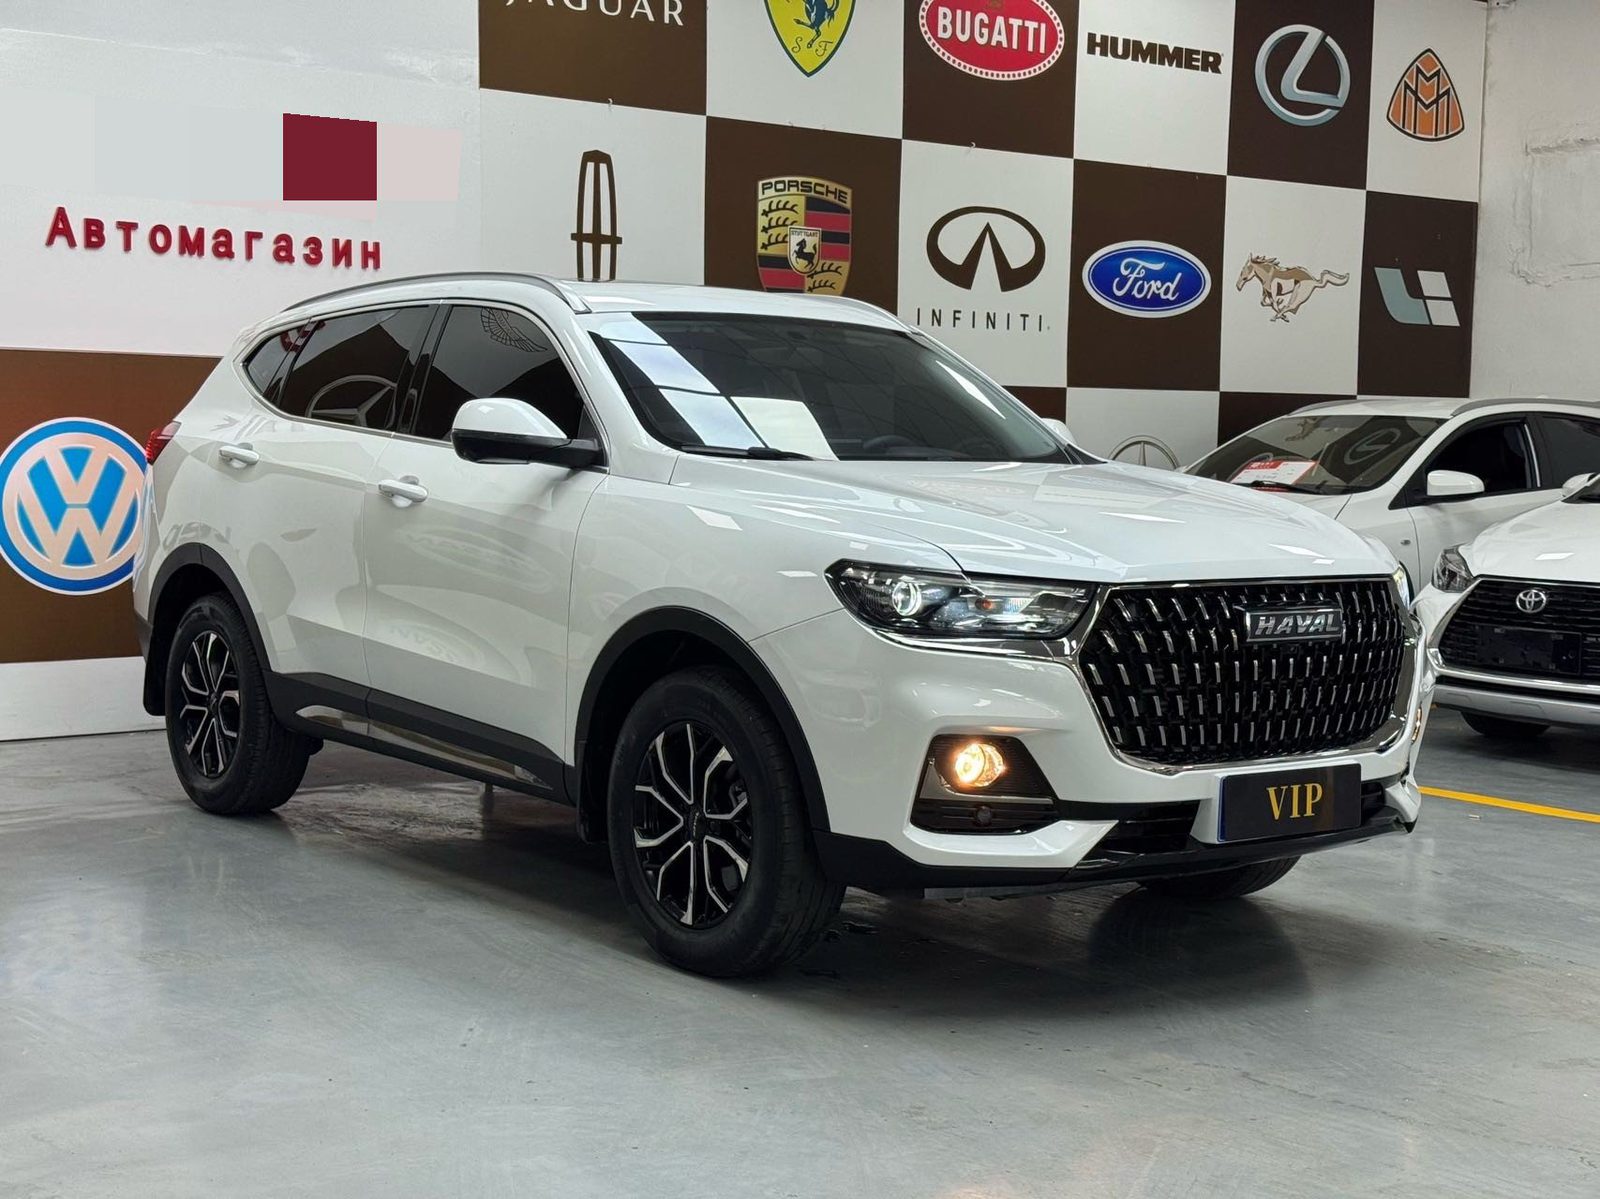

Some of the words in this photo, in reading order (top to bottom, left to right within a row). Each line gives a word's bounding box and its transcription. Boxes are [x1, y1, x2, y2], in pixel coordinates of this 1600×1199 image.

[506, 0, 683, 26] UAR
[937, 6, 1046, 54] BUGATTI
[1087, 32, 1222, 74] HUMMER
[761, 179, 848, 205] PORSCHE
[45, 206, 381, 270] Автомагазин
[1112, 257, 1182, 301] Ford
[916, 307, 1042, 332] INFINITI
[1255, 613, 1339, 635] HAVAL
[1266, 782, 1323, 821] VIP
